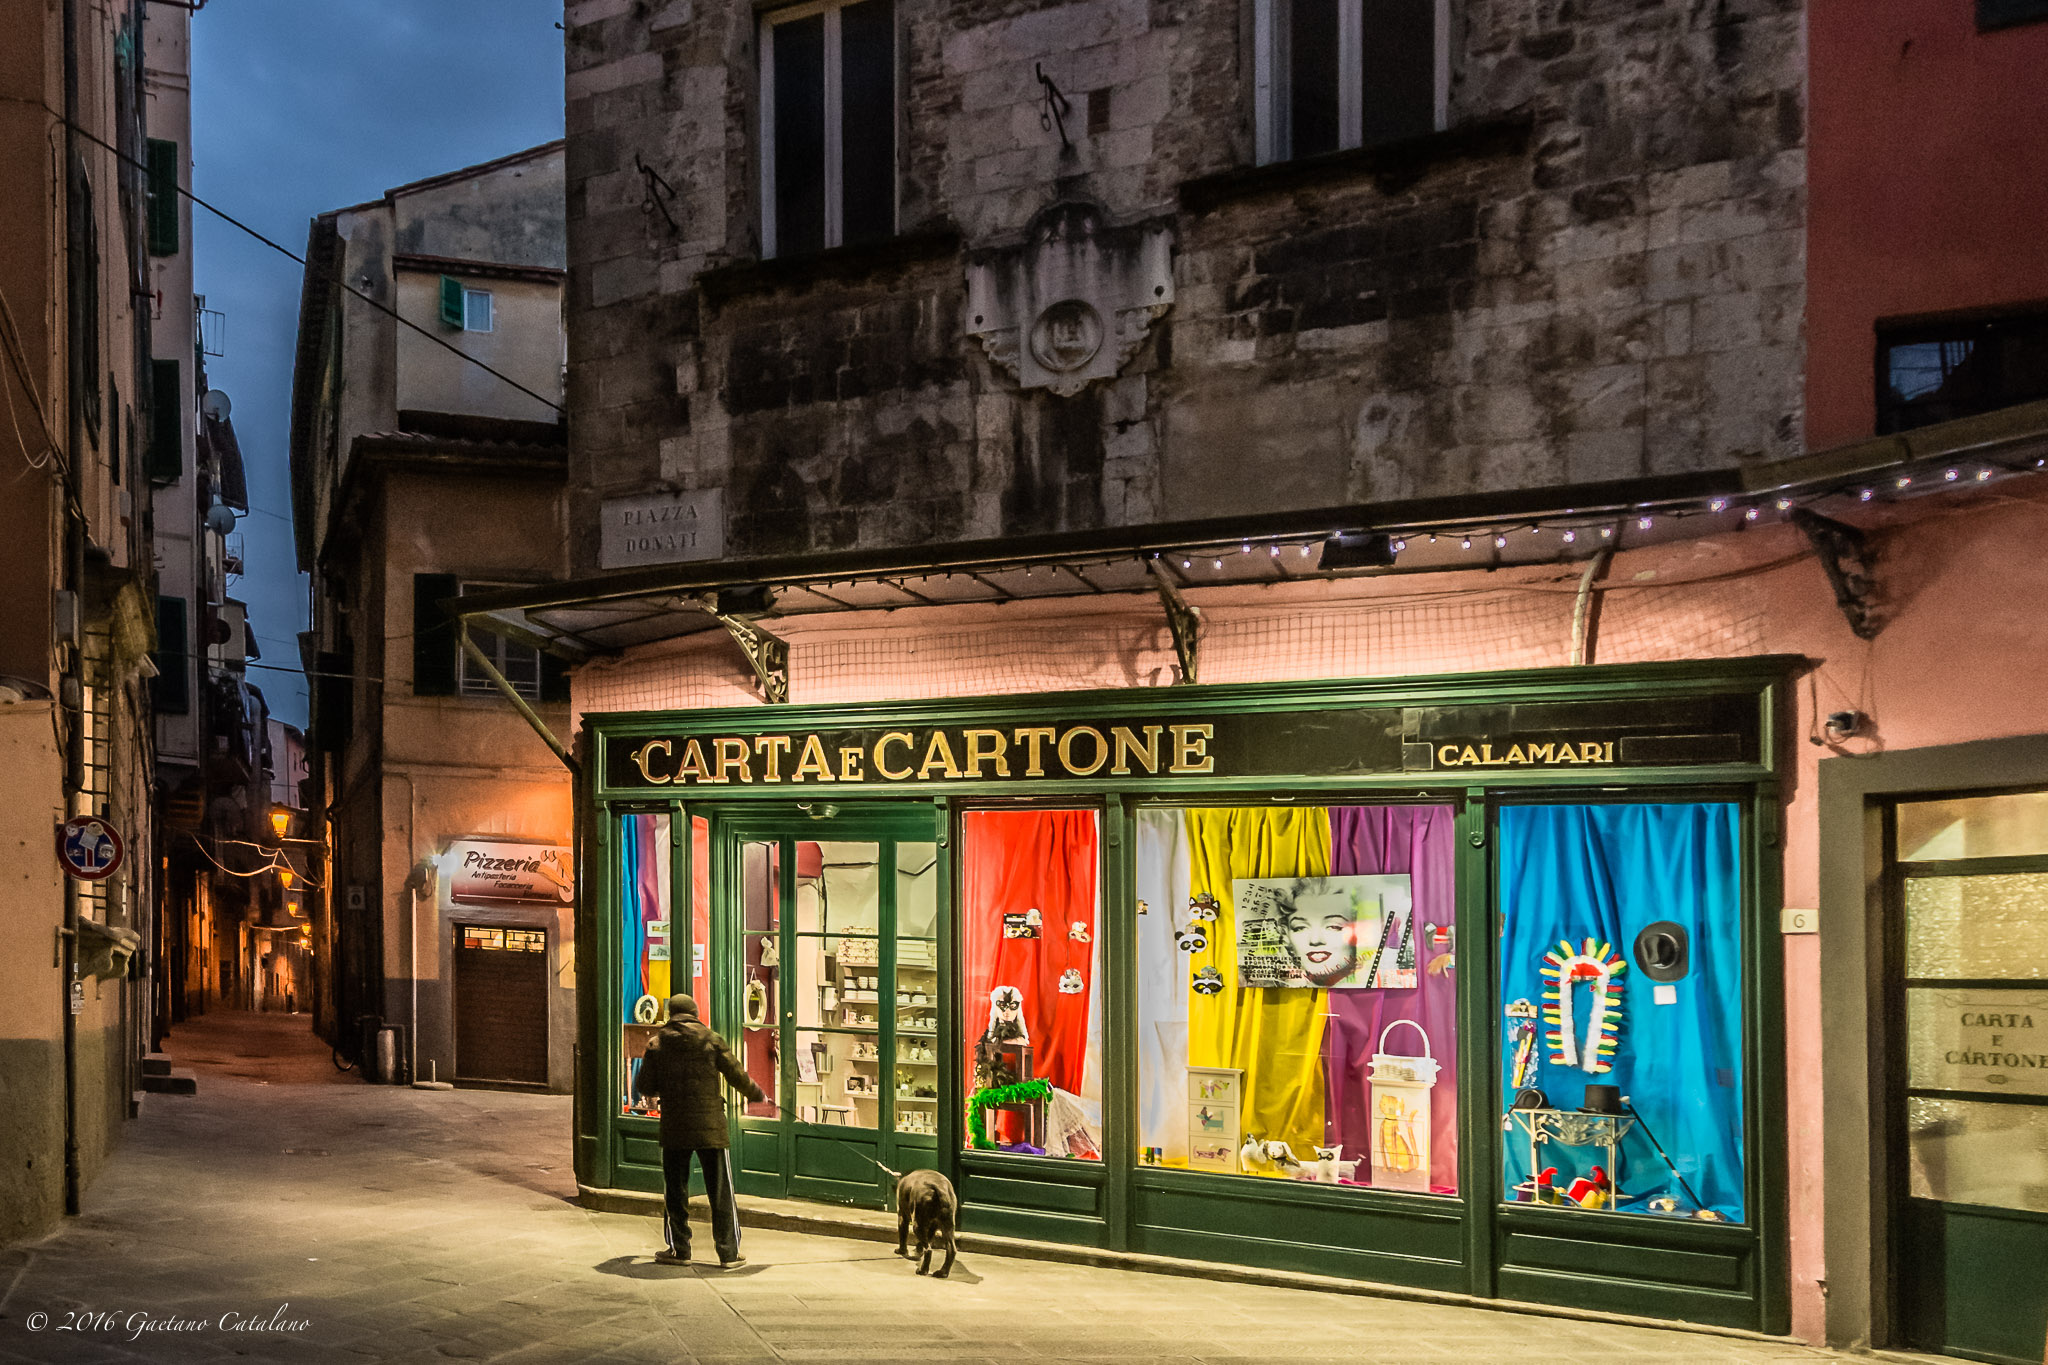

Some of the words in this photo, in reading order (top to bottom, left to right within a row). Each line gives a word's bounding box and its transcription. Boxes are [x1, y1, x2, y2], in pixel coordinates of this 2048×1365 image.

[623, 505, 698, 527] PIAZZA
[626, 532, 697, 553] DONATI
[631, 734, 836, 784] CARTA
[838, 747, 864, 782] E
[873, 724, 1214, 780] CARTONE
[1437, 741, 1614, 766] CALAMARI
[463, 850, 541, 873] Pizzeria
[1793, 913, 1806, 929] 6
[1961, 1012, 2034, 1028] CARTA
[1991, 1034, 2004, 1047] E
